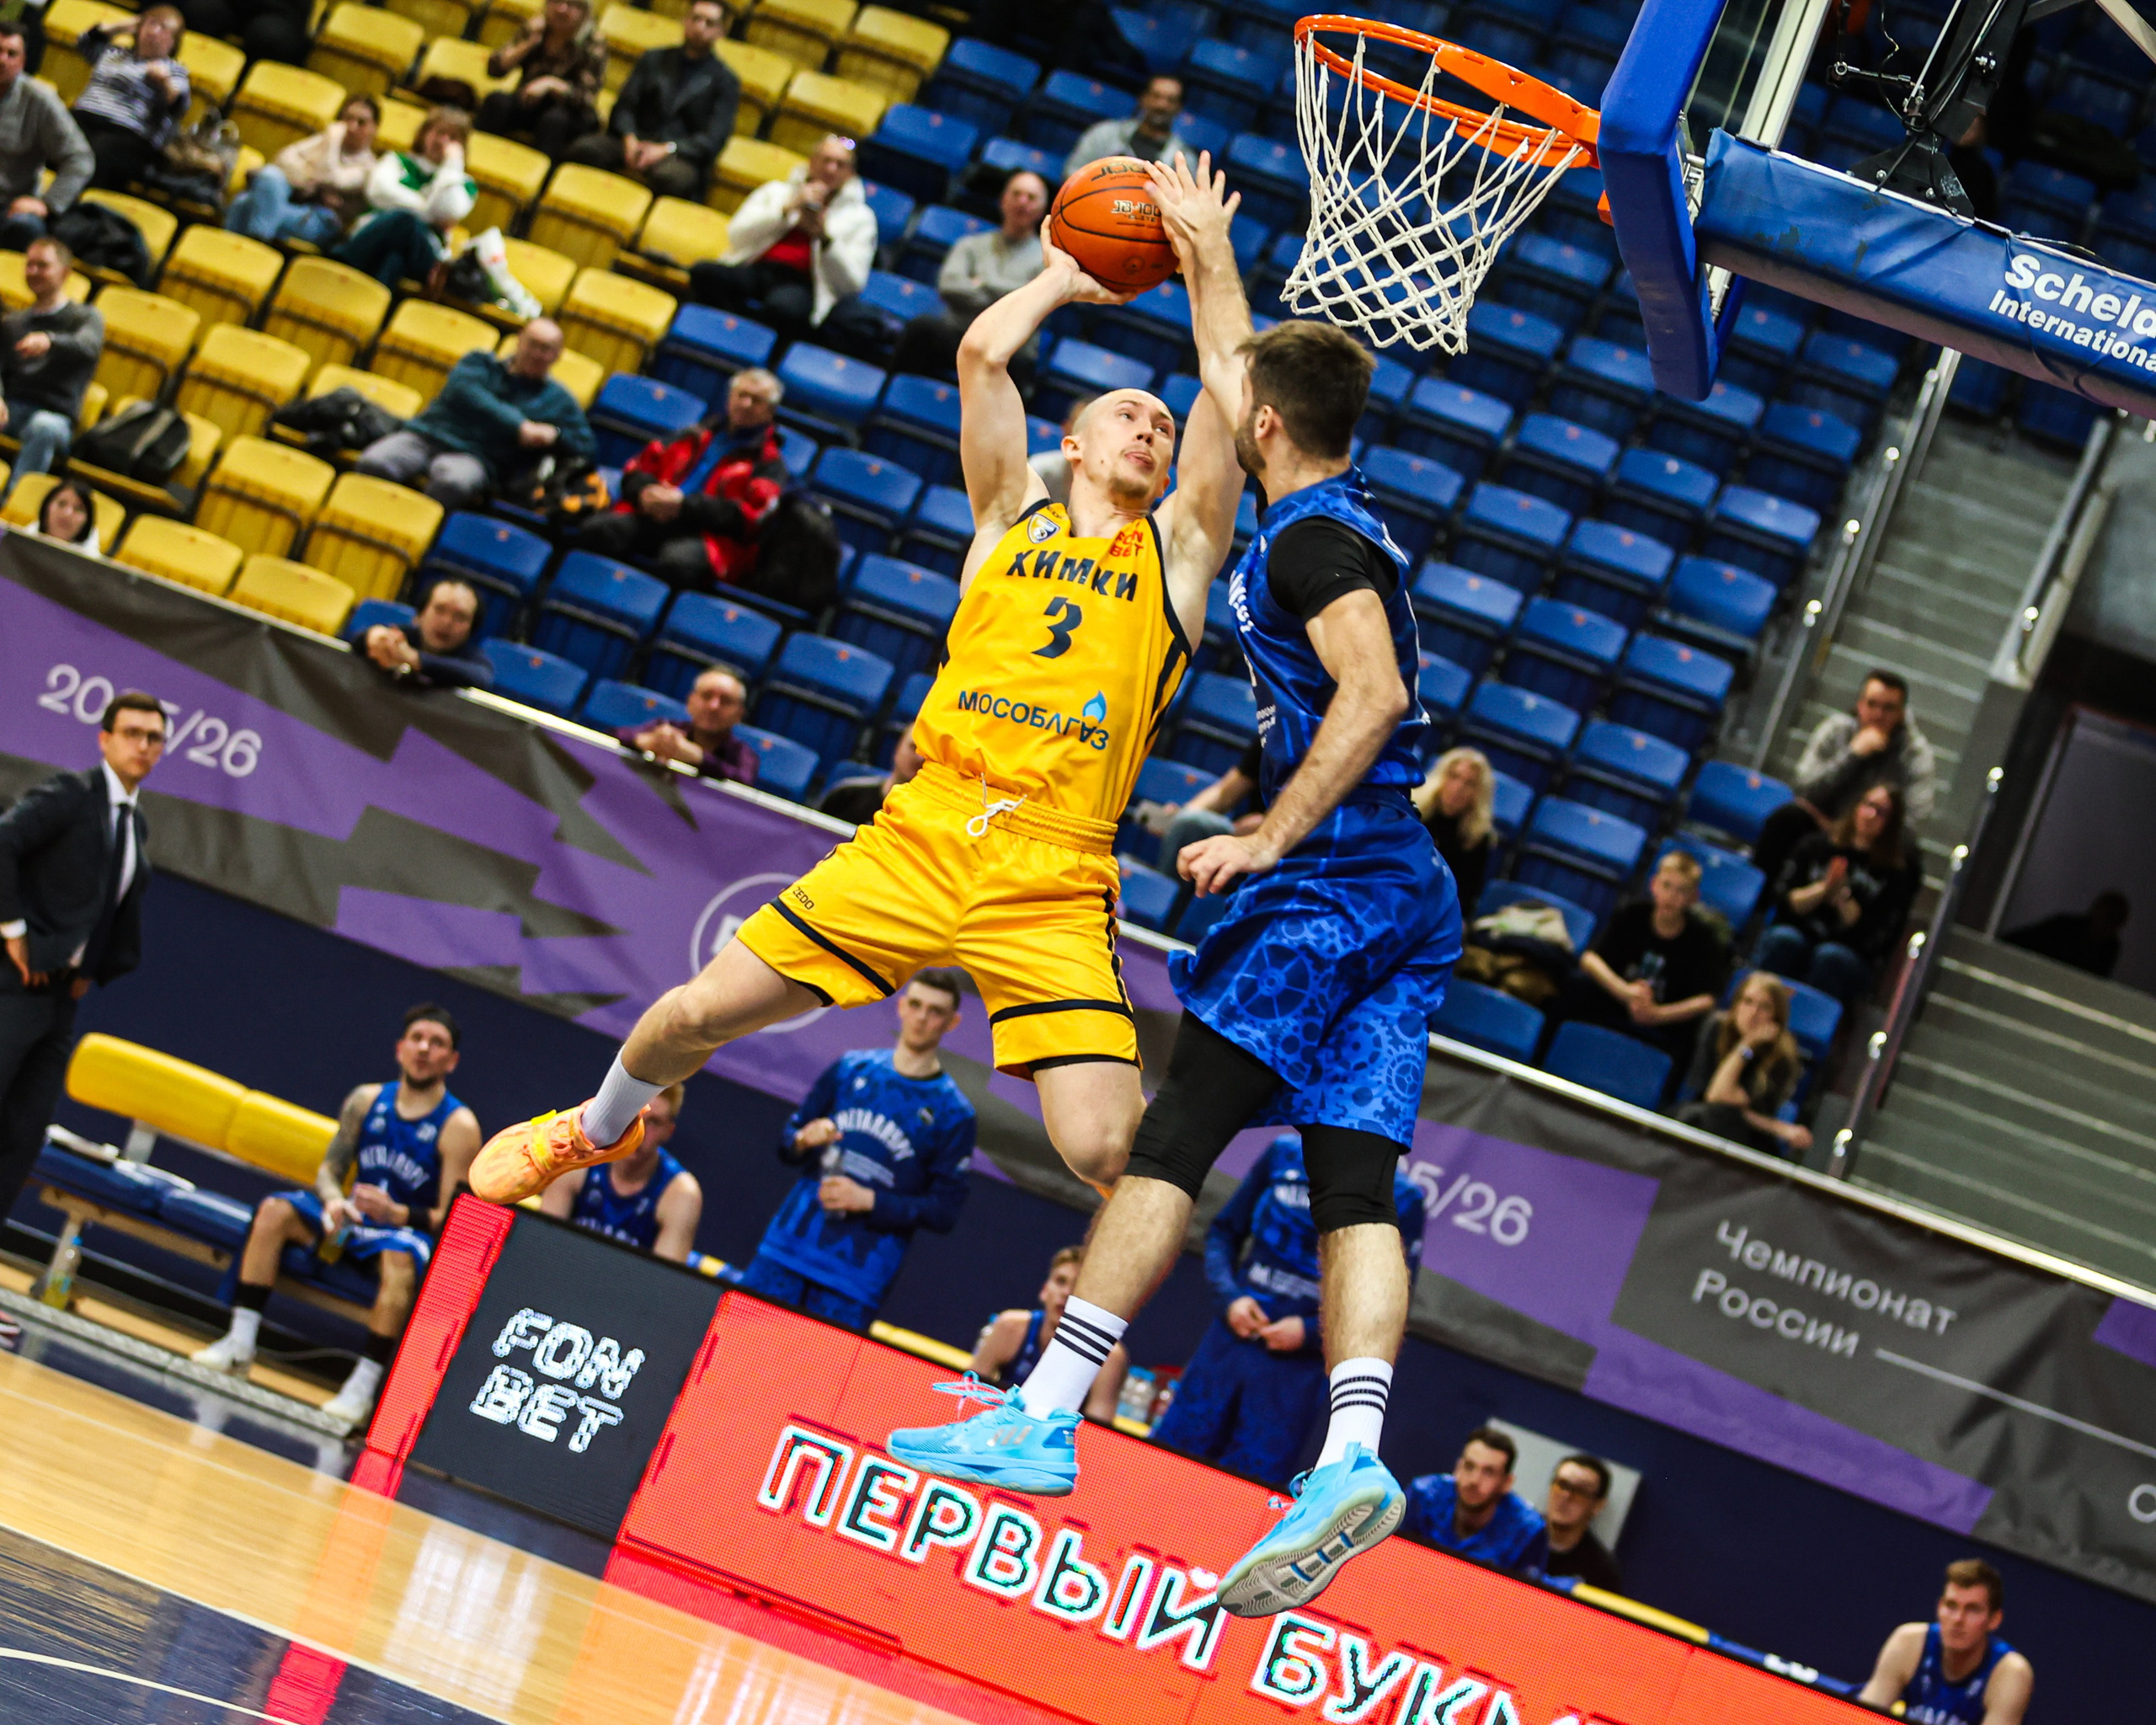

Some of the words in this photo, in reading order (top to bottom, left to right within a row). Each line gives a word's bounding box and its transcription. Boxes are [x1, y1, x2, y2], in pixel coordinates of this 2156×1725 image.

[1006, 548, 1139, 601] ХИМКИ
[1031, 596, 1082, 659] 3
[37, 664, 263, 778] 205/26
[792, 887, 815, 911] ZEDO
[1398, 1155, 1534, 1246] 5/26
[1690, 1268, 1860, 1359] России
[1716, 1220, 1958, 1336] Чемпионат
[492, 1307, 646, 1400] FON
[469, 1364, 624, 1453] BET
[757, 1424, 1228, 1671] ПЕРВЫЙ
